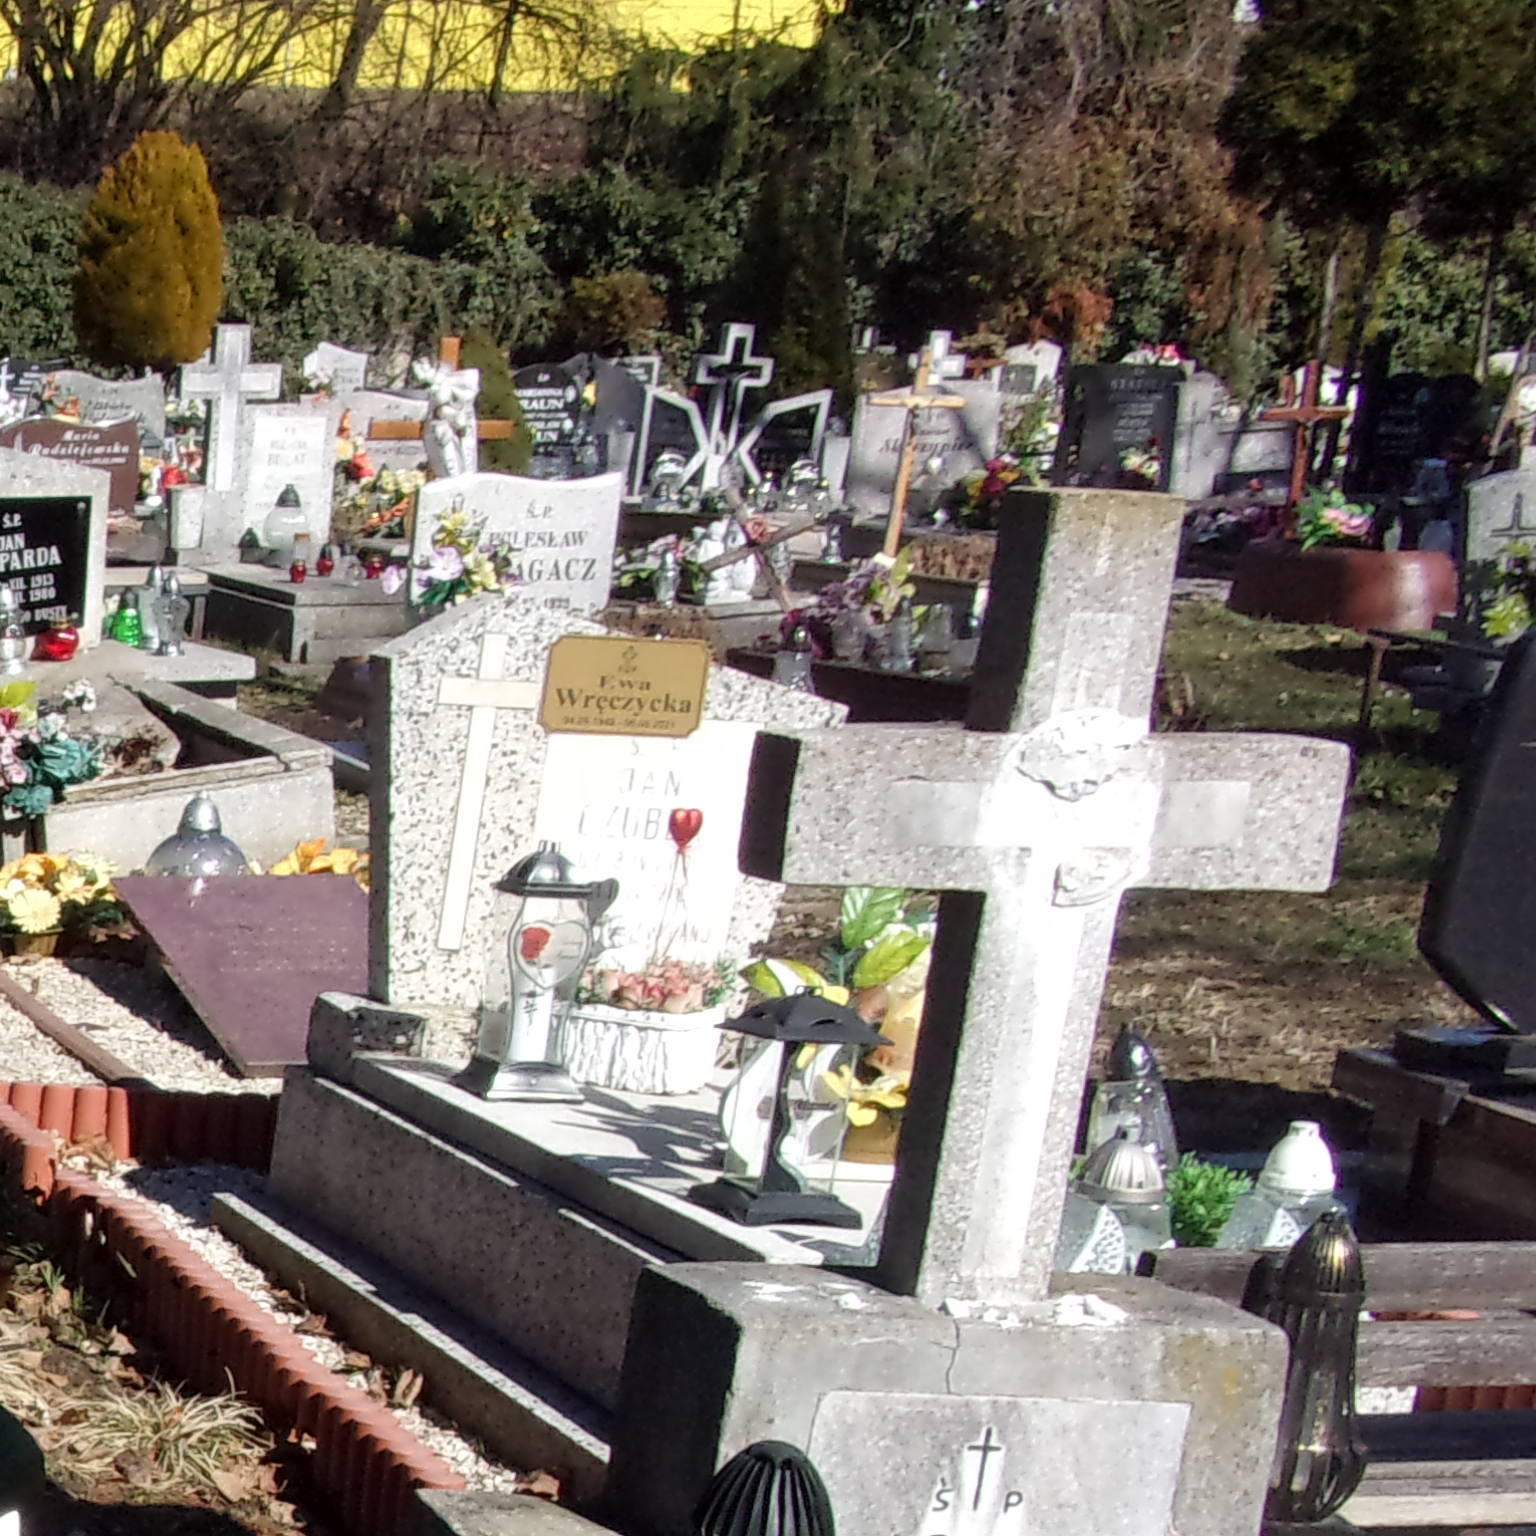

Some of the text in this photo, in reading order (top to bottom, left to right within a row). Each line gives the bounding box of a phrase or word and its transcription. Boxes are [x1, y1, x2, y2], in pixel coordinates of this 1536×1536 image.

[598, 675, 651, 691] Ewa
[555, 687, 693, 717] Wręczycka
[578, 804, 680, 841] CZUB
[1003, 1490, 1024, 1514] P
